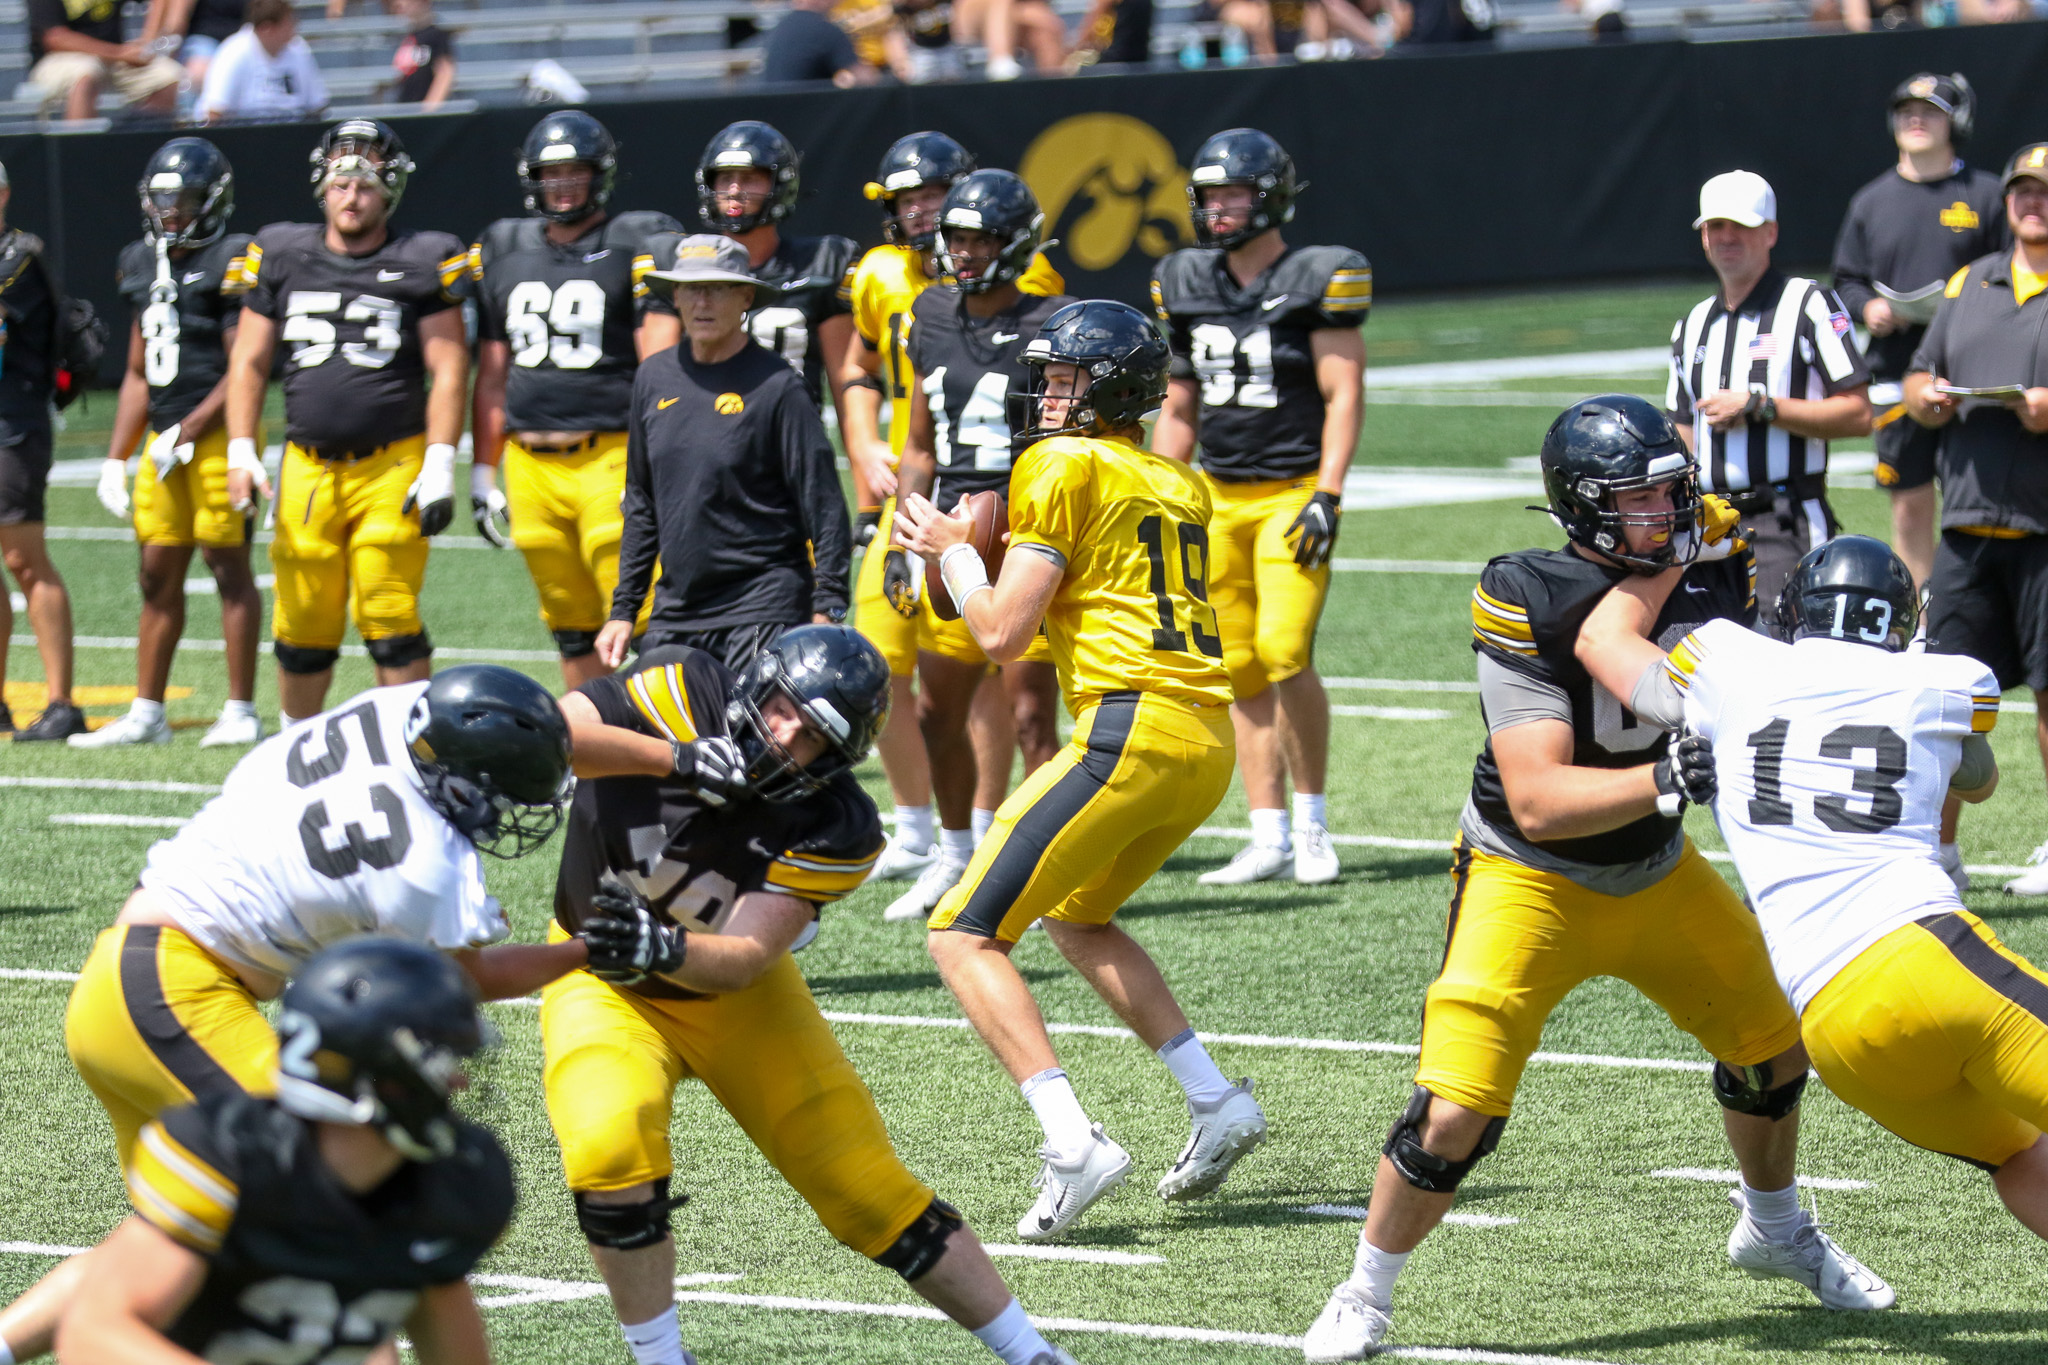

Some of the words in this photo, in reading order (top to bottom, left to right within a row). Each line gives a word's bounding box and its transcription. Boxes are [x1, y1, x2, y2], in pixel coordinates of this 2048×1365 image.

[141, 301, 180, 387] 8
[282, 290, 402, 368] 53
[505, 280, 606, 369] 69
[922, 366, 1012, 472] 14
[1137, 515, 1223, 659] 19
[1830, 594, 1892, 643] 13
[286, 700, 414, 880] 53
[1746, 717, 1908, 834] 13
